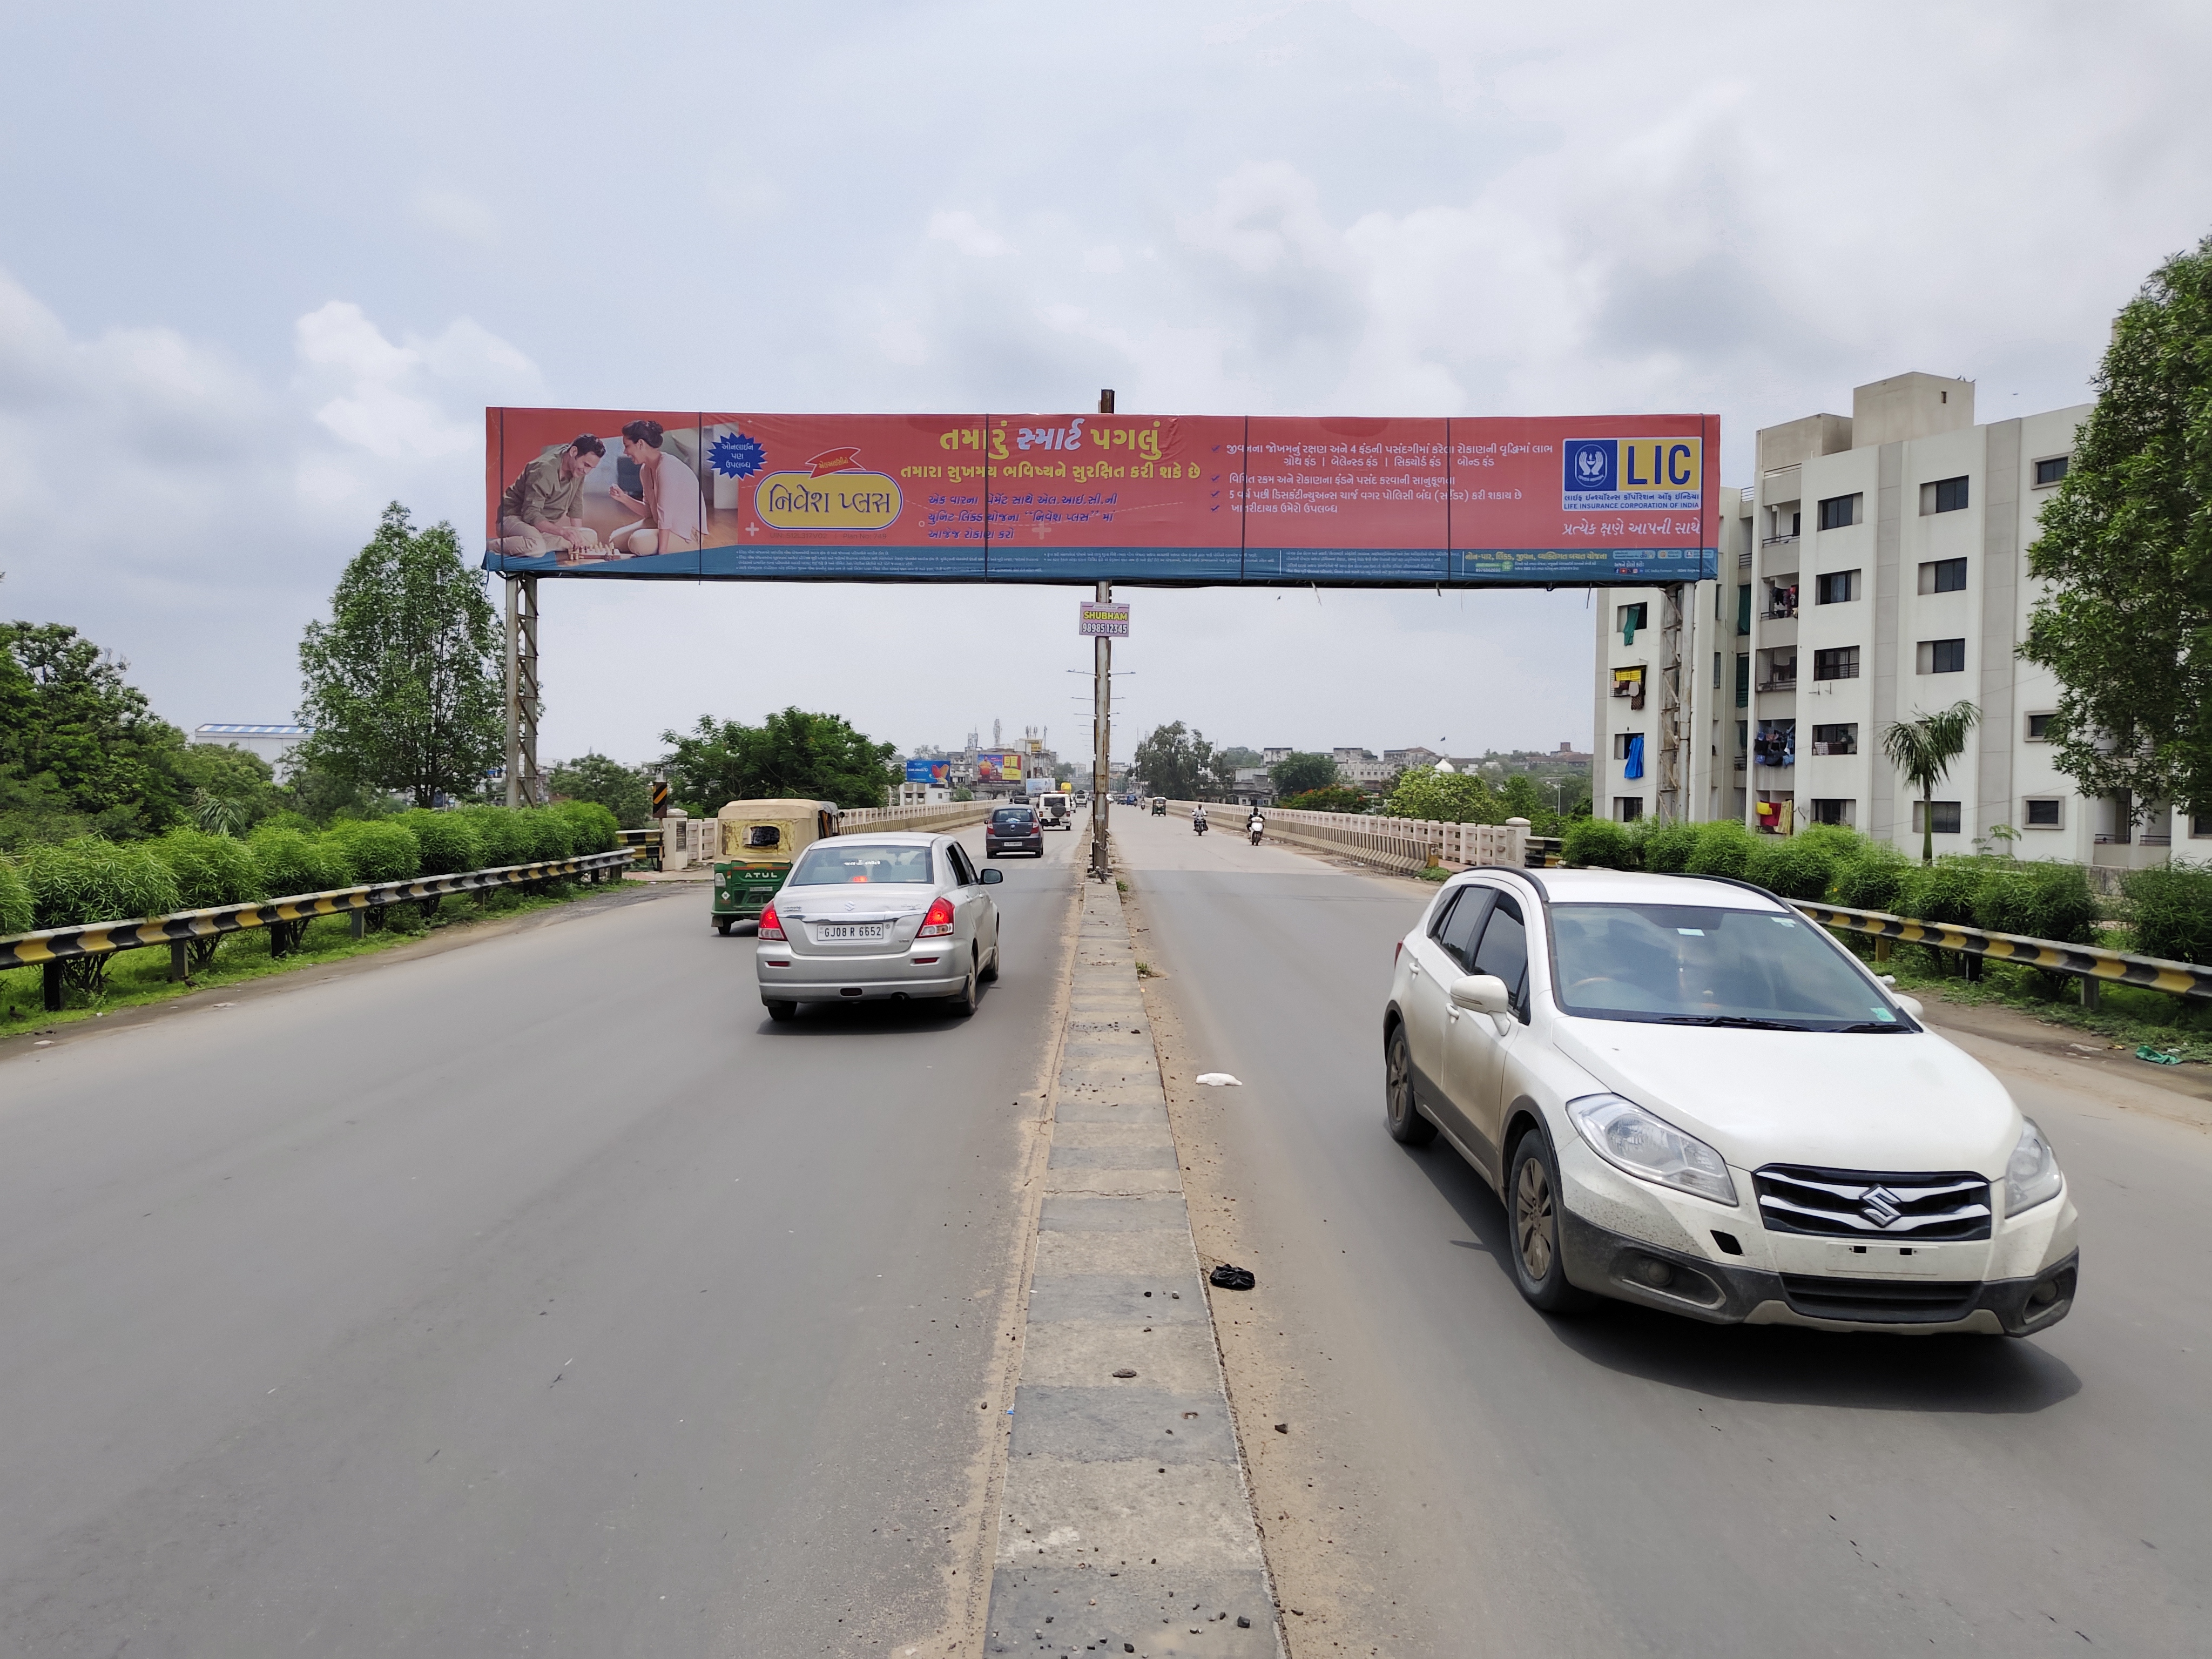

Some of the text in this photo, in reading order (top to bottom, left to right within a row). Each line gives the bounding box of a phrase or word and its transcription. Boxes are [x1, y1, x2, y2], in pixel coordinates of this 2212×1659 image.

[940, 418, 1162, 460] તમારું સ્માર્ટ પગલું
[721, 442, 753, 450] ઓનલાઈન
[1265, 442, 1301, 456] જોખમનું
[1303, 445, 1326, 454] રક્ષણ
[1330, 443, 1347, 453] અને
[1350, 445, 1356, 454] 4
[1359, 443, 1382, 454] ફંડની
[1385, 443, 1430, 454] પસંદગીમાં
[1457, 443, 1496, 454] રોકાણની
[1532, 445, 1553, 453] લાભ
[726, 460, 751, 469] ઉપલબ્ધ
[1284, 455, 1301, 466] ગ્રોથ
[1304, 455, 1316, 467] ફંડ
[1366, 455, 1378, 467] ફંડ
[1429, 455, 1441, 467] ફંડ
[1457, 456, 1480, 466] બોન્ડ
[1482, 455, 1494, 467] ફંડ
[1627, 444, 1690, 484] LIC
[901, 461, 1201, 483] તમારા સુખમય ભવિષ્યને સુરક્ષિત કરી શકે છે
[1277, 473, 1293, 484] અને
[1296, 473, 1332, 484] રોકાણના
[1335, 473, 1353, 485] ફંડને
[1356, 473, 1377, 484] પસંદ
[1379, 474, 1410, 484] કરવાની
[769, 483, 890, 512] નિવેશ પ્લસ
[928, 493, 946, 505] એક
[949, 496, 979, 505] વારના
[1012, 493, 1034, 505] સાથે
[1229, 490, 1235, 499] 5
[1253, 489, 1269, 500] પછી
[1340, 489, 1359, 500] ચાર્જ
[1361, 491, 1379, 500] વગર
[1382, 489, 1413, 500] પોલિસી
[1416, 489, 1431, 500] બંધ
[1472, 489, 1485, 500] કરી
[1488, 491, 1512, 500] શકાય
[1514, 489, 1522, 500] છે
[1280, 502, 1300, 512] ઉમેરો
[1304, 503, 1337, 513] ઉપલબ્ધ
[928, 510, 955, 525] યુનિટ
[987, 511, 1019, 522] યોજના
[1562, 517, 1701, 536] પ્રત્યેક ક્ષણે આપની સાથે
[998, 527, 1015, 539] કરો
[1083, 611, 1128, 621] SHUBHAM
[1082, 623, 1128, 634] 98985 12345
[825, 927, 881, 937] GJ08 R 6652
